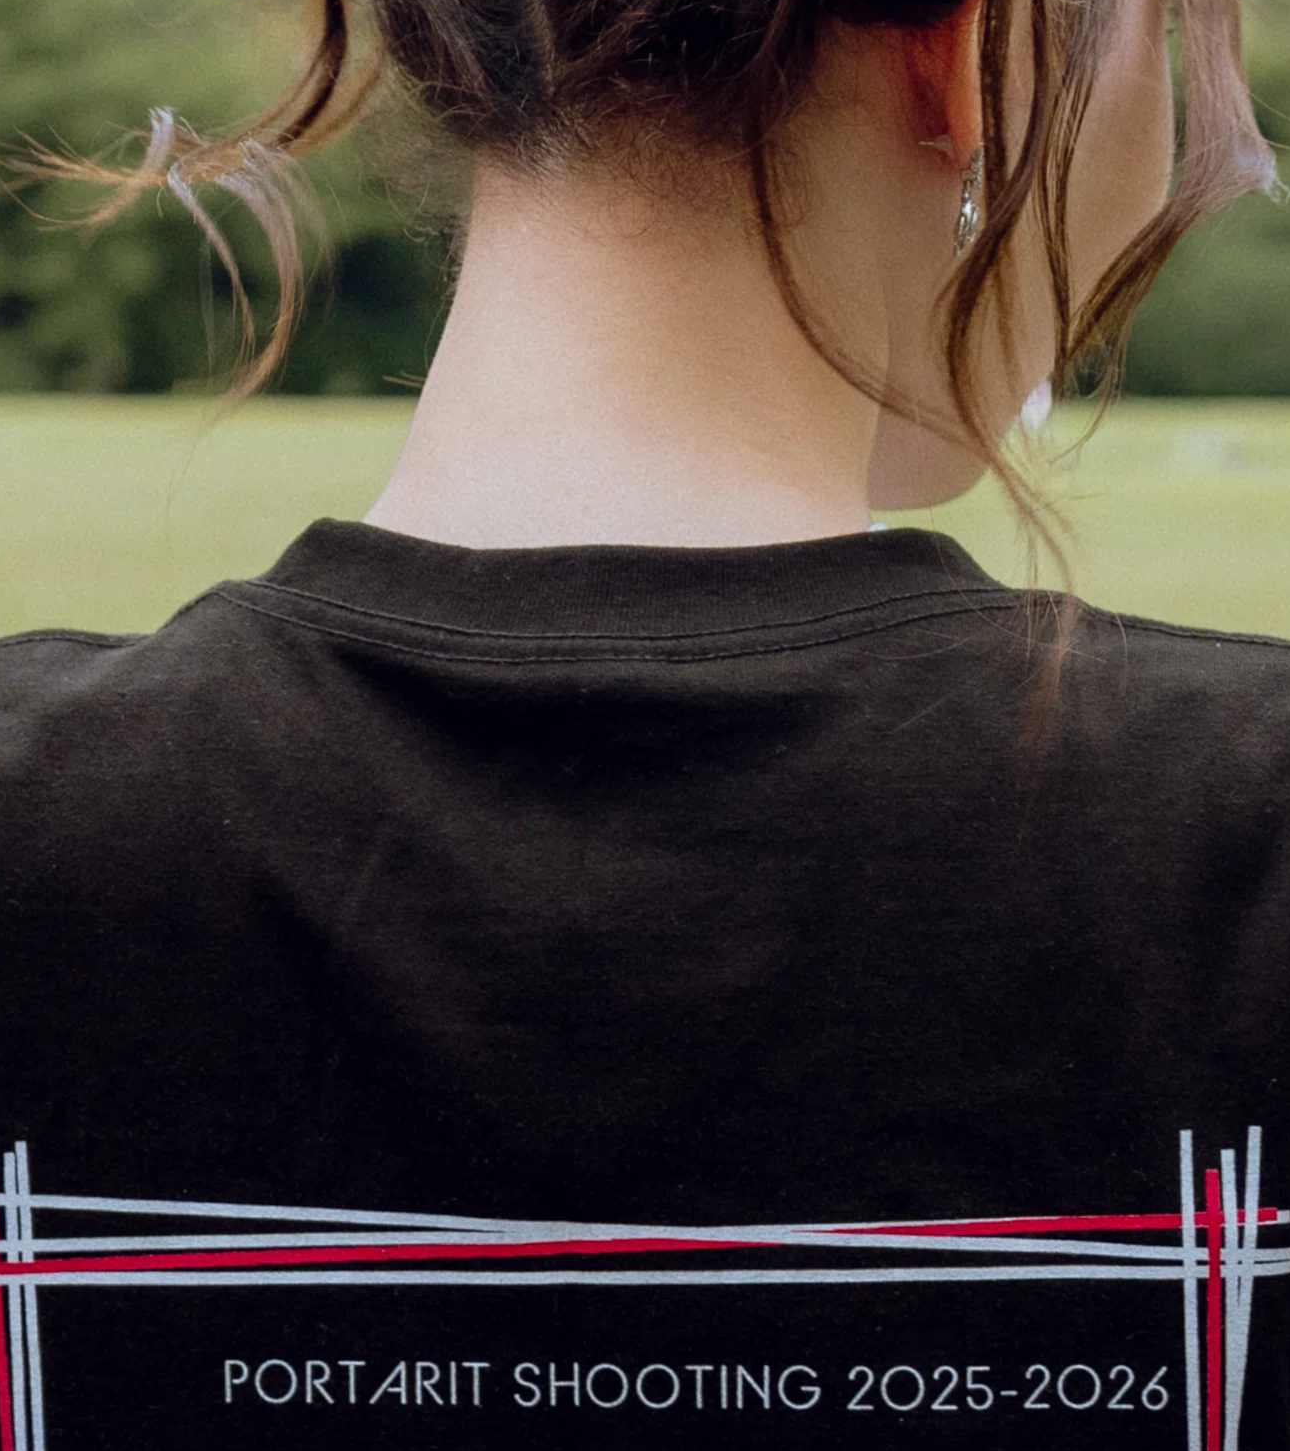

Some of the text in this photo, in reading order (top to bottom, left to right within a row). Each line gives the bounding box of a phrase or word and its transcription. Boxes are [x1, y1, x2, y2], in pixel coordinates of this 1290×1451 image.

[222, 1357, 1170, 1412] PORTARIT SHOOTING 2025-2026
